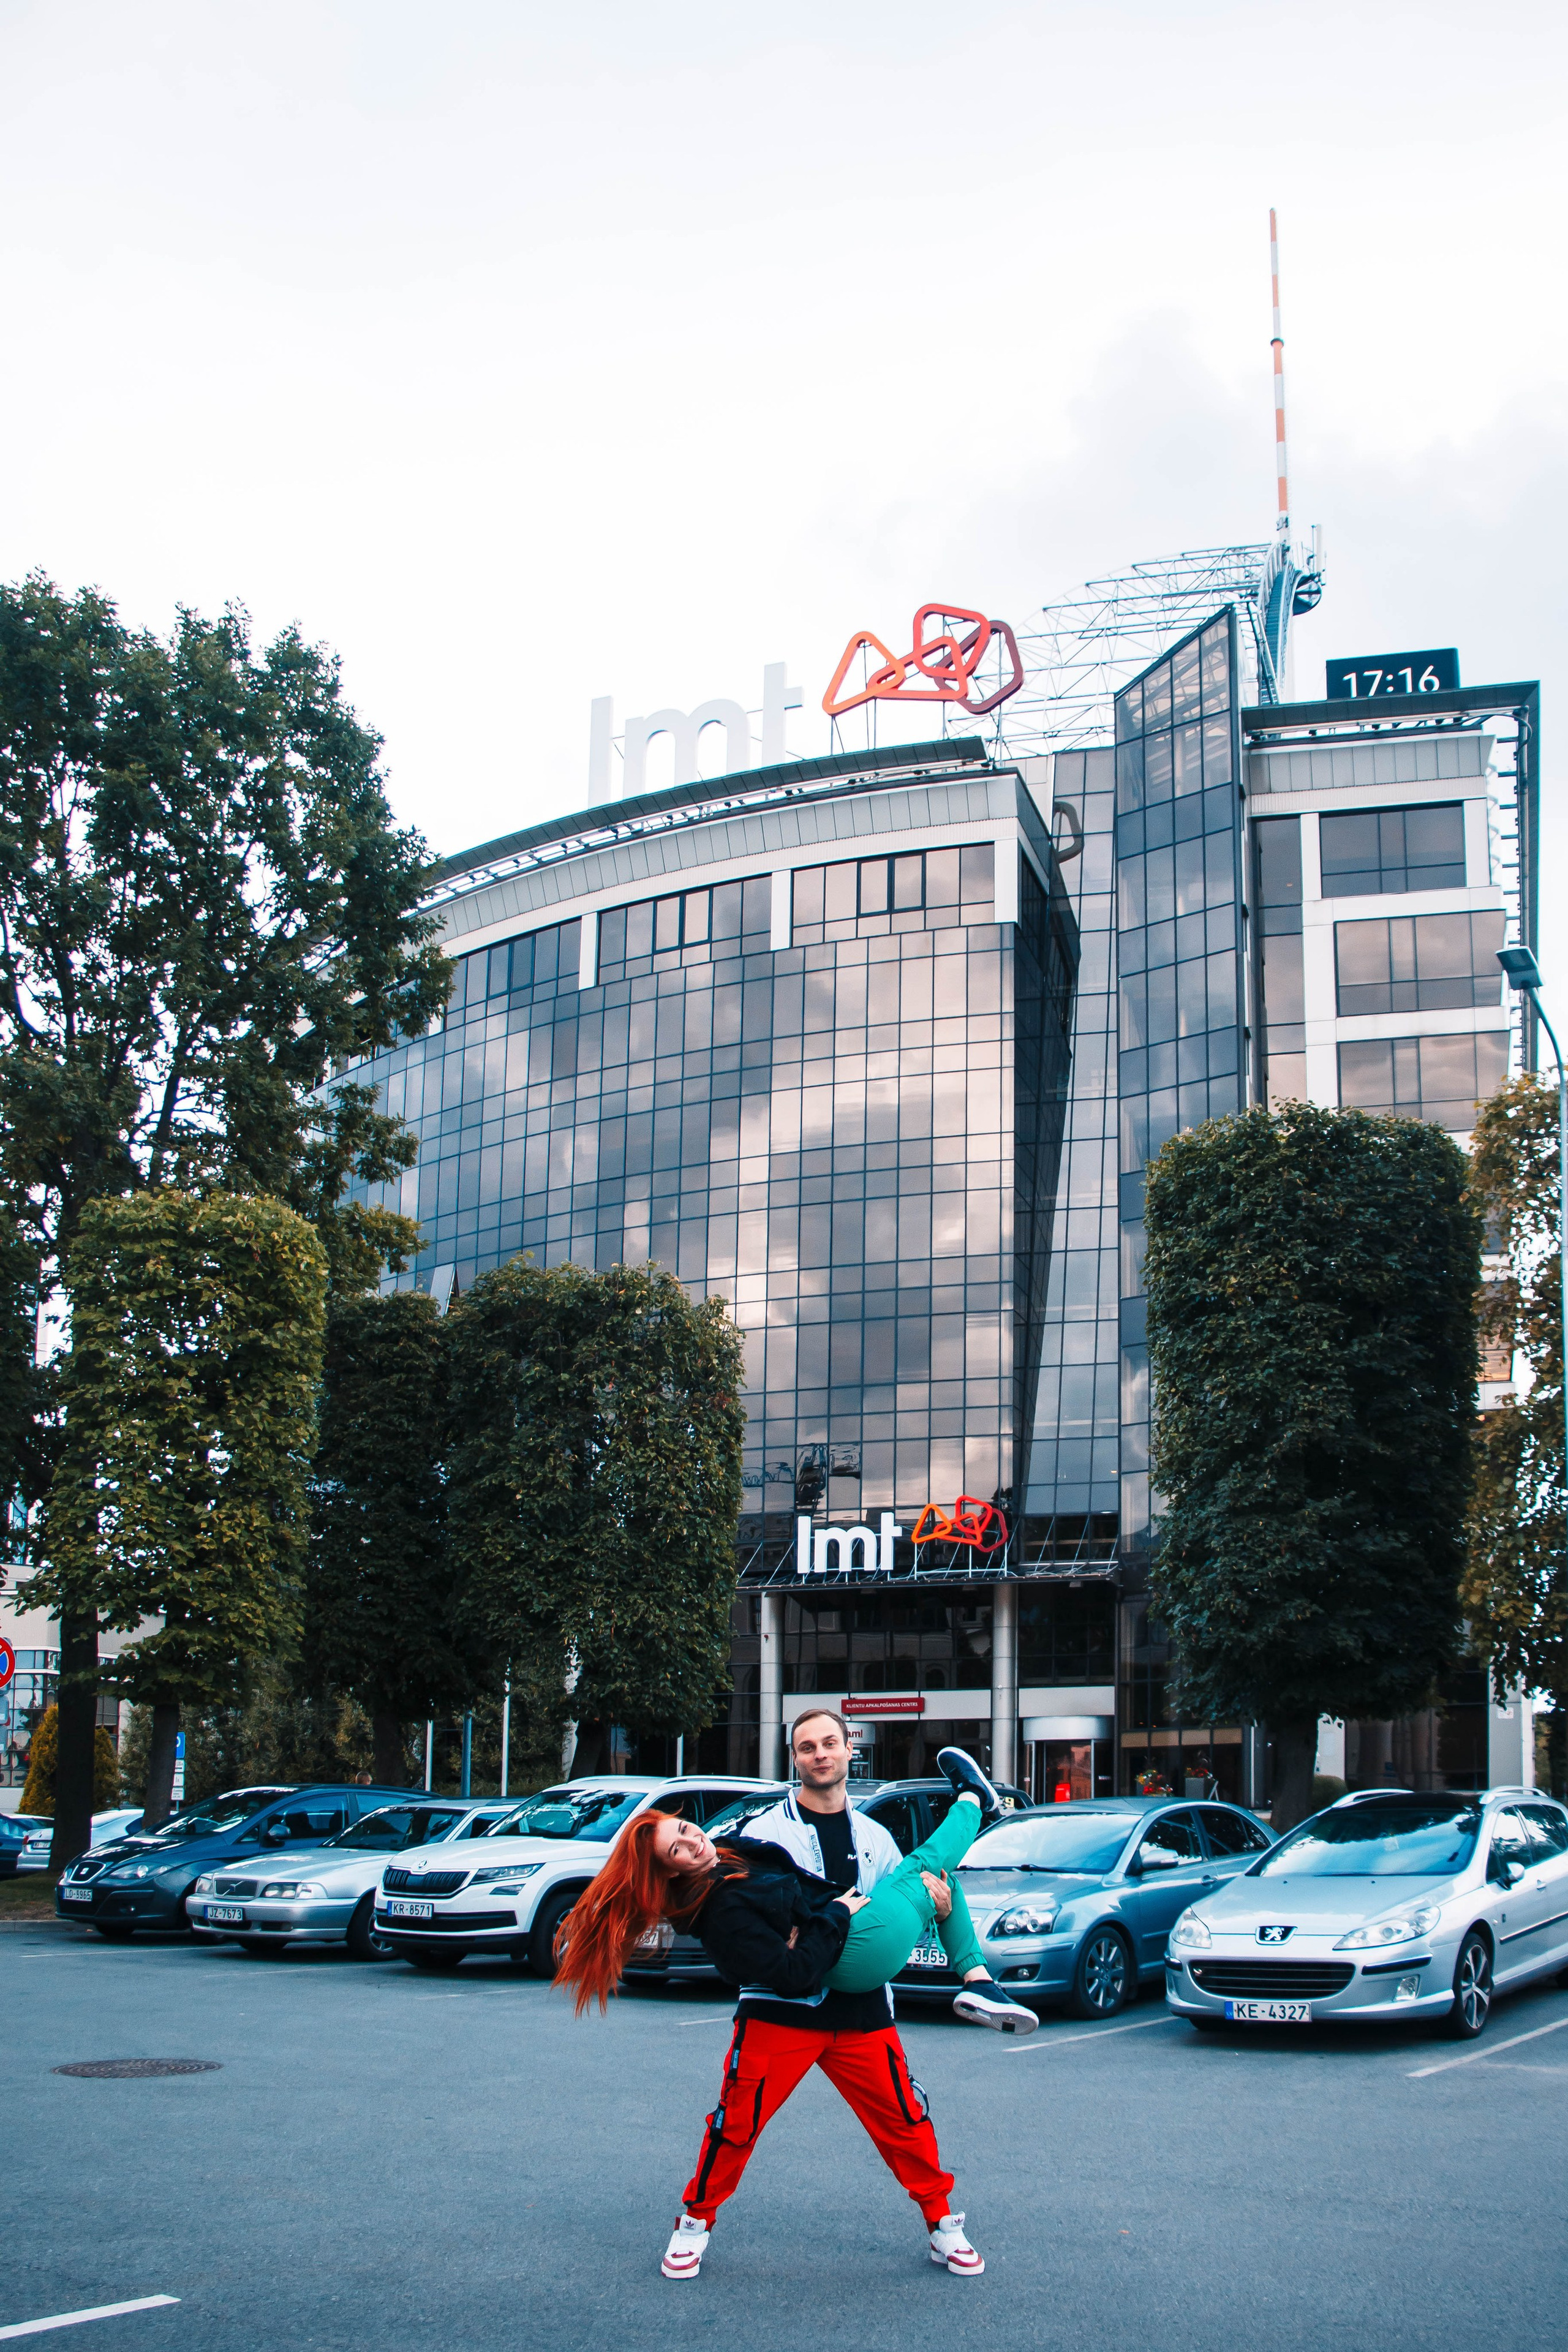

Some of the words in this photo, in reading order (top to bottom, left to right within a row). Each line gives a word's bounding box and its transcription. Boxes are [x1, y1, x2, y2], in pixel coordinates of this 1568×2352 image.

[1343, 665, 1440, 699] 17:16
[588, 662, 804, 809] lmt
[797, 1512, 902, 1574] lmt
[209, 1907, 242, 1919] JZ-7673
[394, 1903, 431, 1916] KR-8571
[1237, 2003, 1307, 2020] KE-4327
